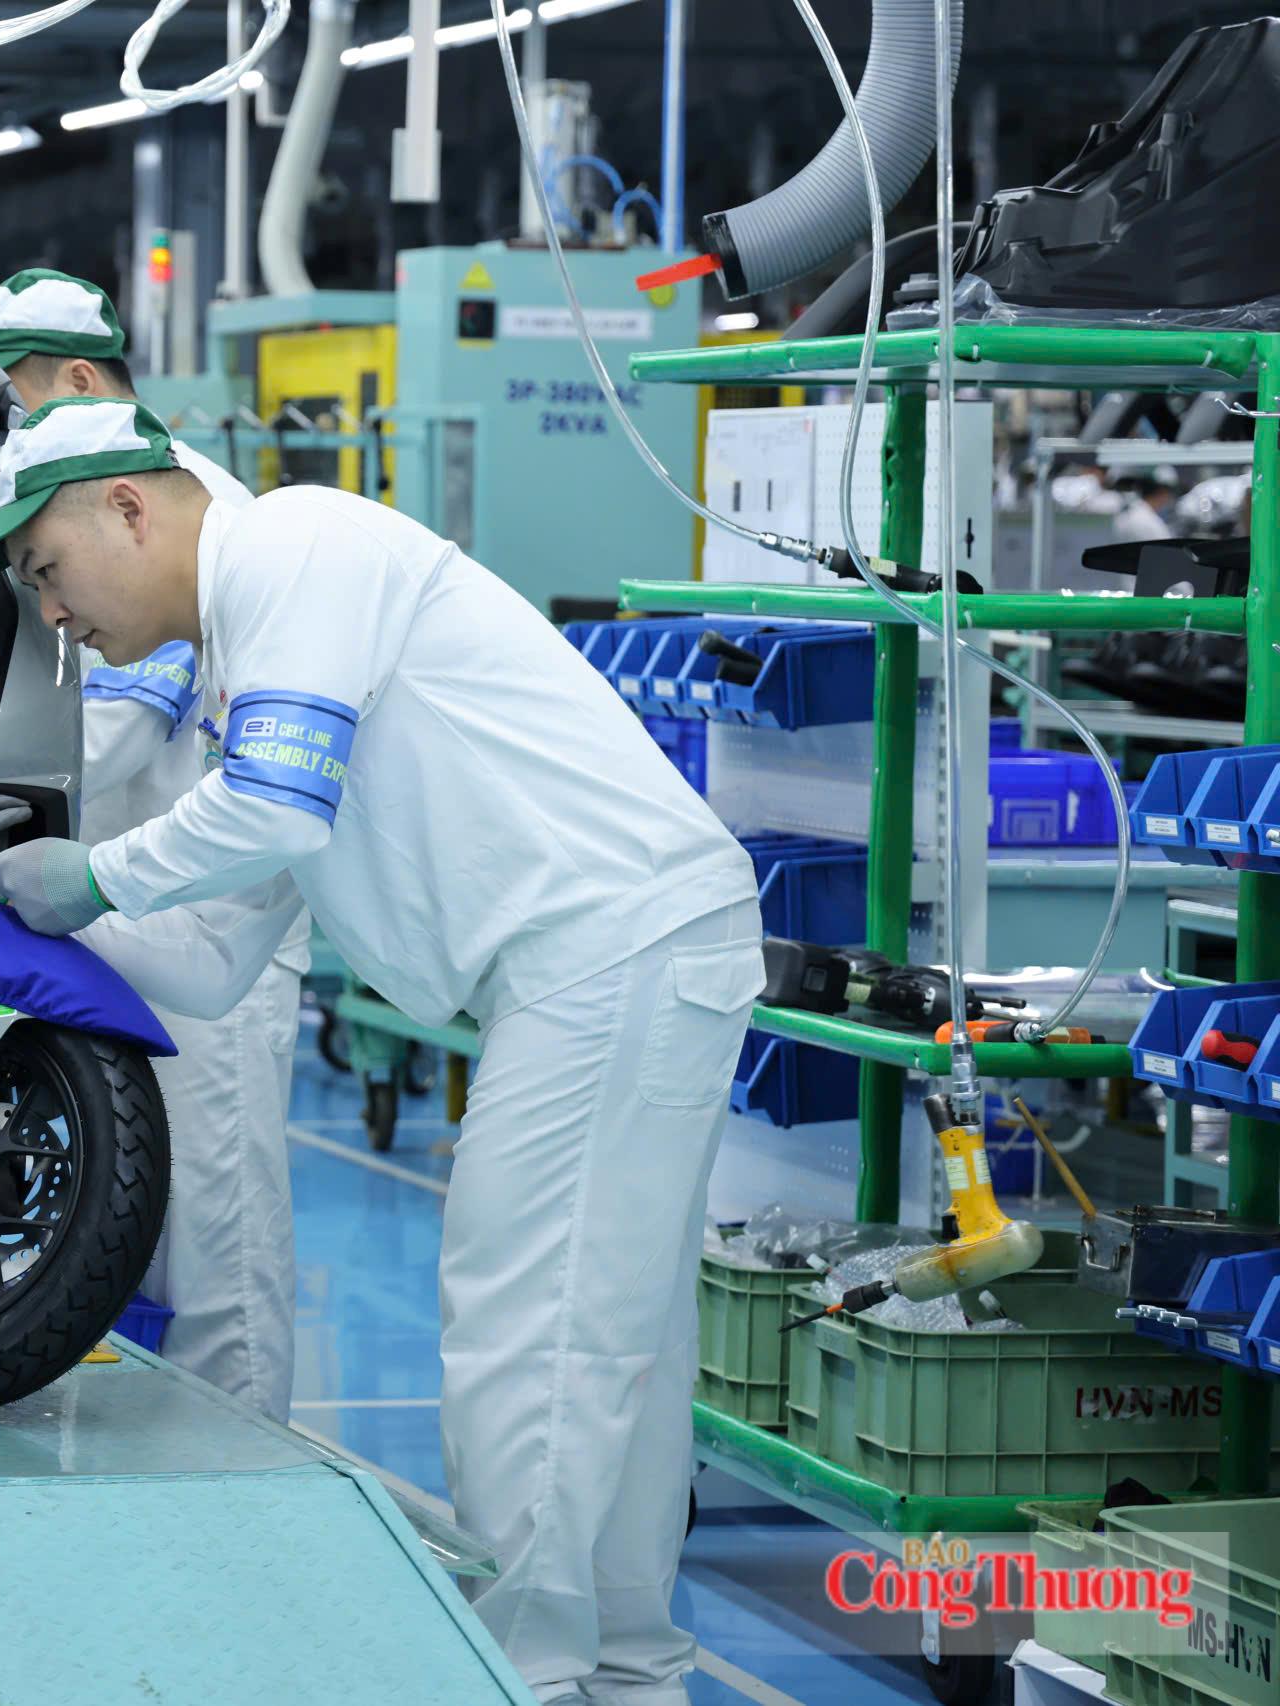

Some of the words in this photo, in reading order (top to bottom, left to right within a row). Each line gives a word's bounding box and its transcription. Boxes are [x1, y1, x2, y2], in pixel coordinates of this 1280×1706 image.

[540, 411, 607, 435] 2KVA
[278, 722, 305, 740] CELL
[307, 728, 333, 749] LINE
[235, 741, 322, 772] ASSEMBLY
[1075, 1386, 1223, 1418] HVN-MS
